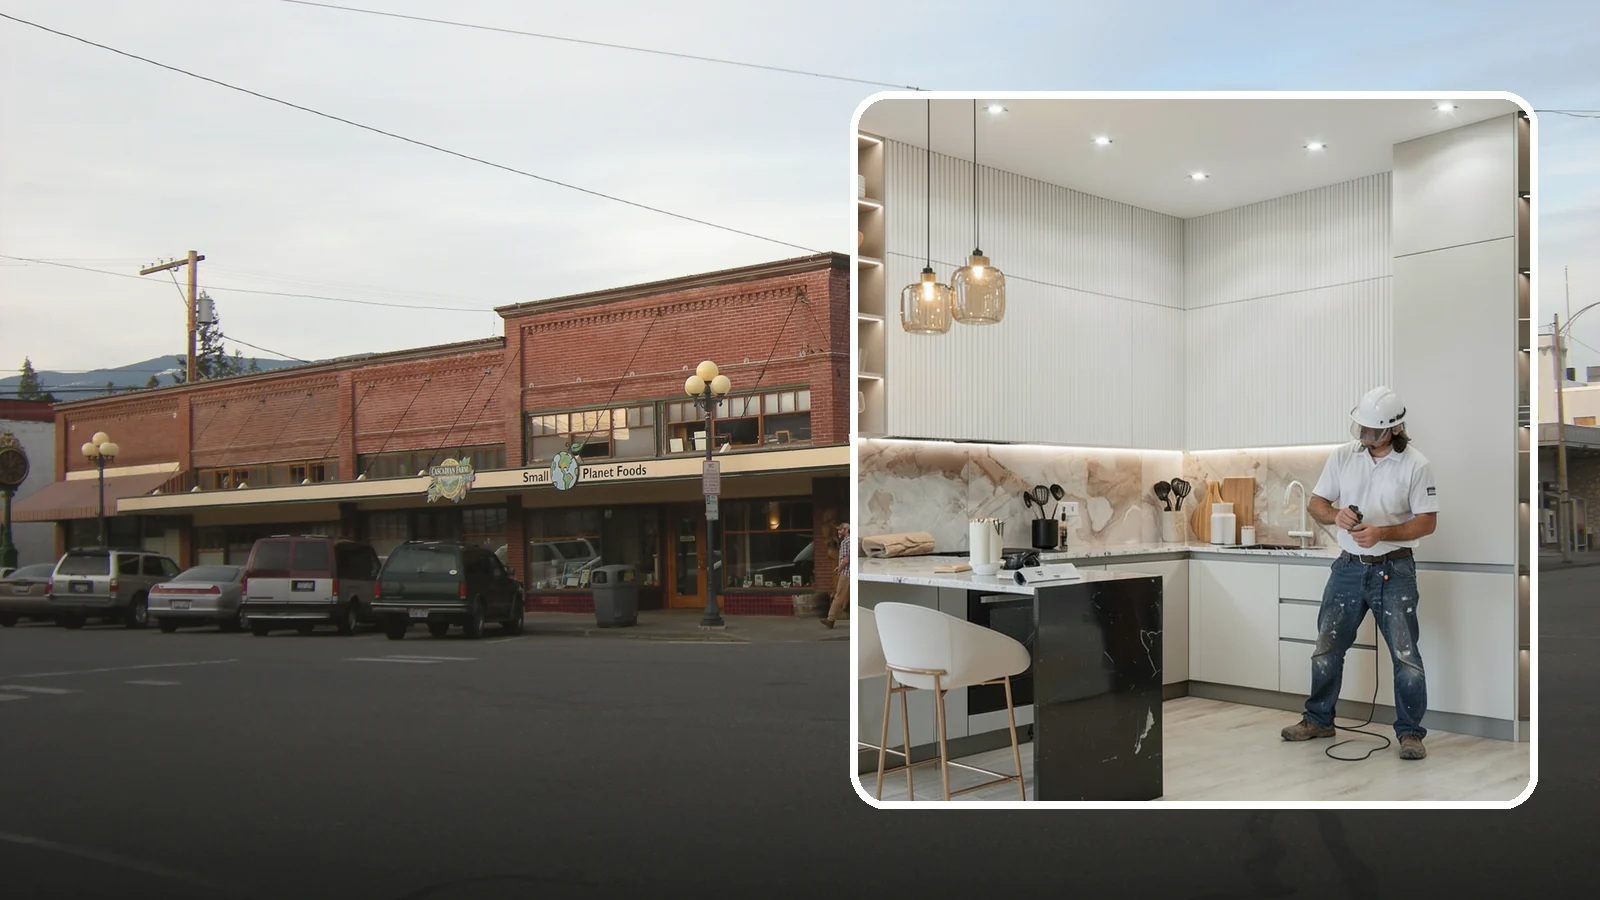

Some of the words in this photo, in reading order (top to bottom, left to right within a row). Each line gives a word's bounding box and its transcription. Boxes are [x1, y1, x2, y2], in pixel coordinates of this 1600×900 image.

[431, 467, 455, 476] CASCADIAN
[456, 466, 468, 474] FARM
[523, 470, 549, 483] Small
[583, 467, 614, 479] Planet
[617, 464, 647, 476] Foods
